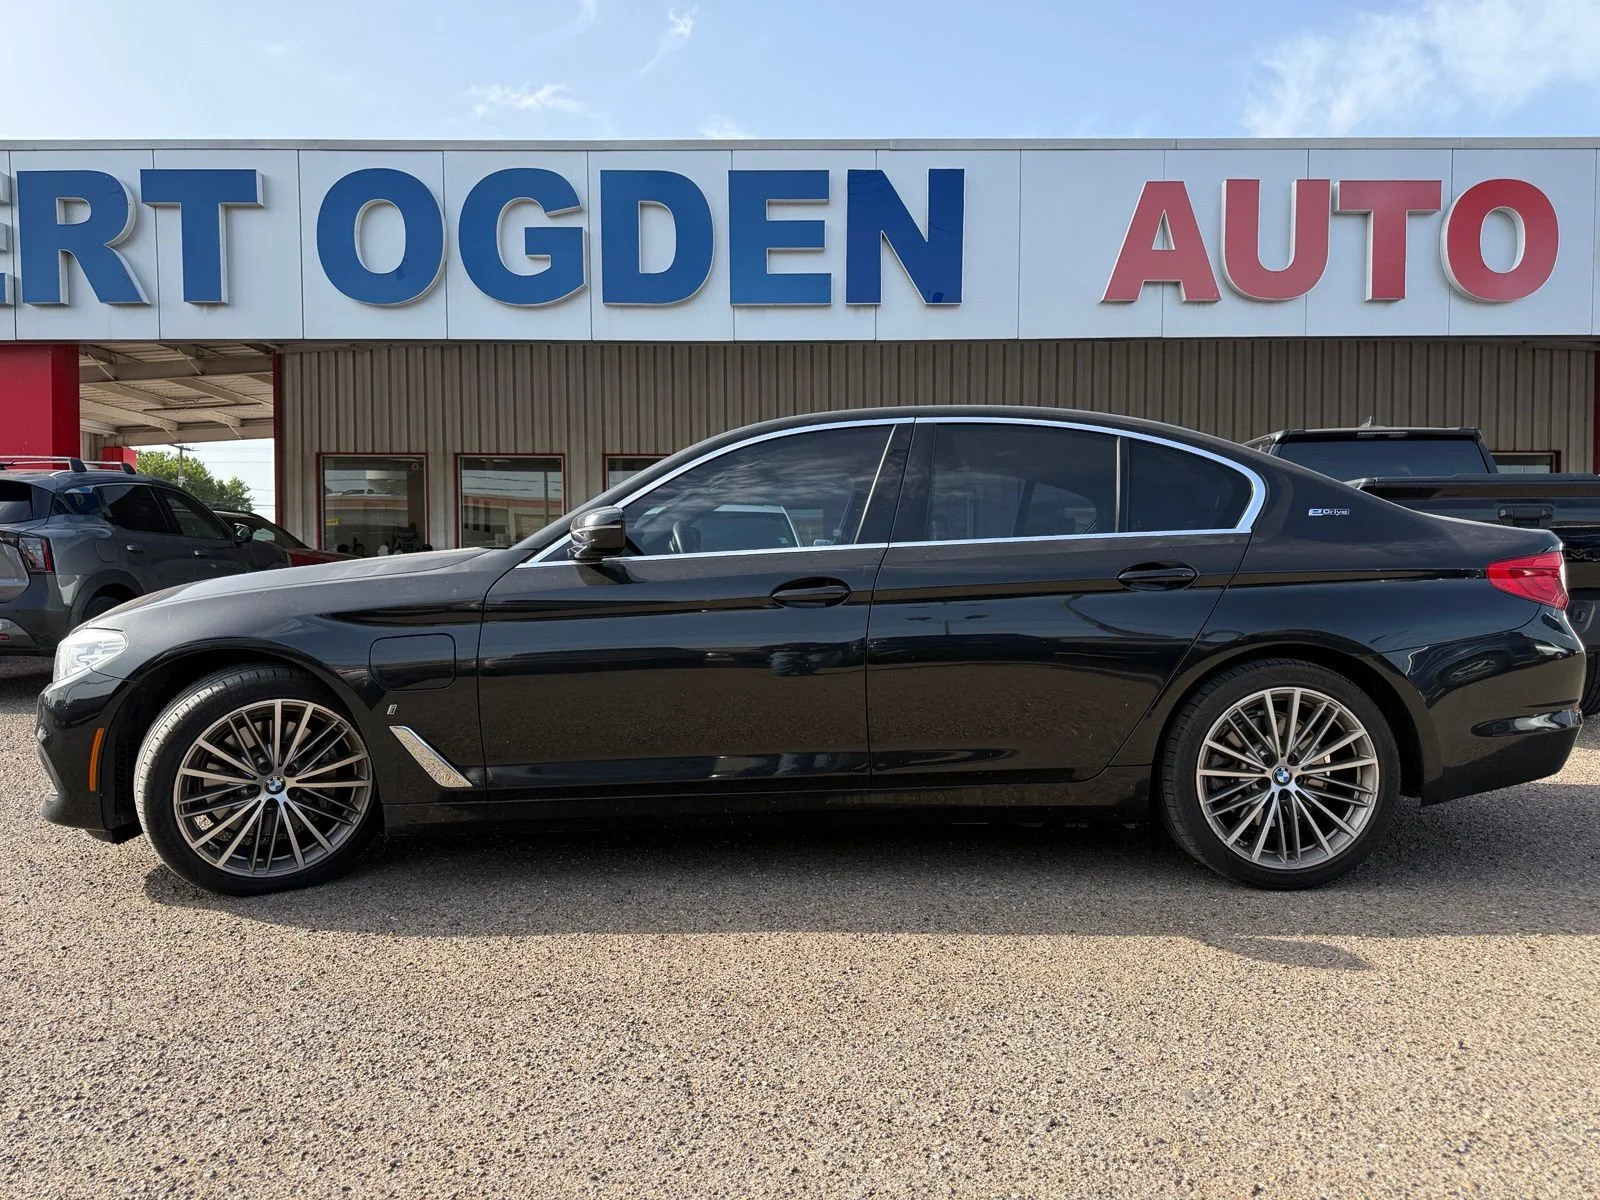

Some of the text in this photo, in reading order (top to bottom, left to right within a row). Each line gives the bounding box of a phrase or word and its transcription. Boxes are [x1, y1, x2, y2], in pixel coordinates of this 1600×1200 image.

[0, 167, 1559, 306] RT OGDEN AUTO
